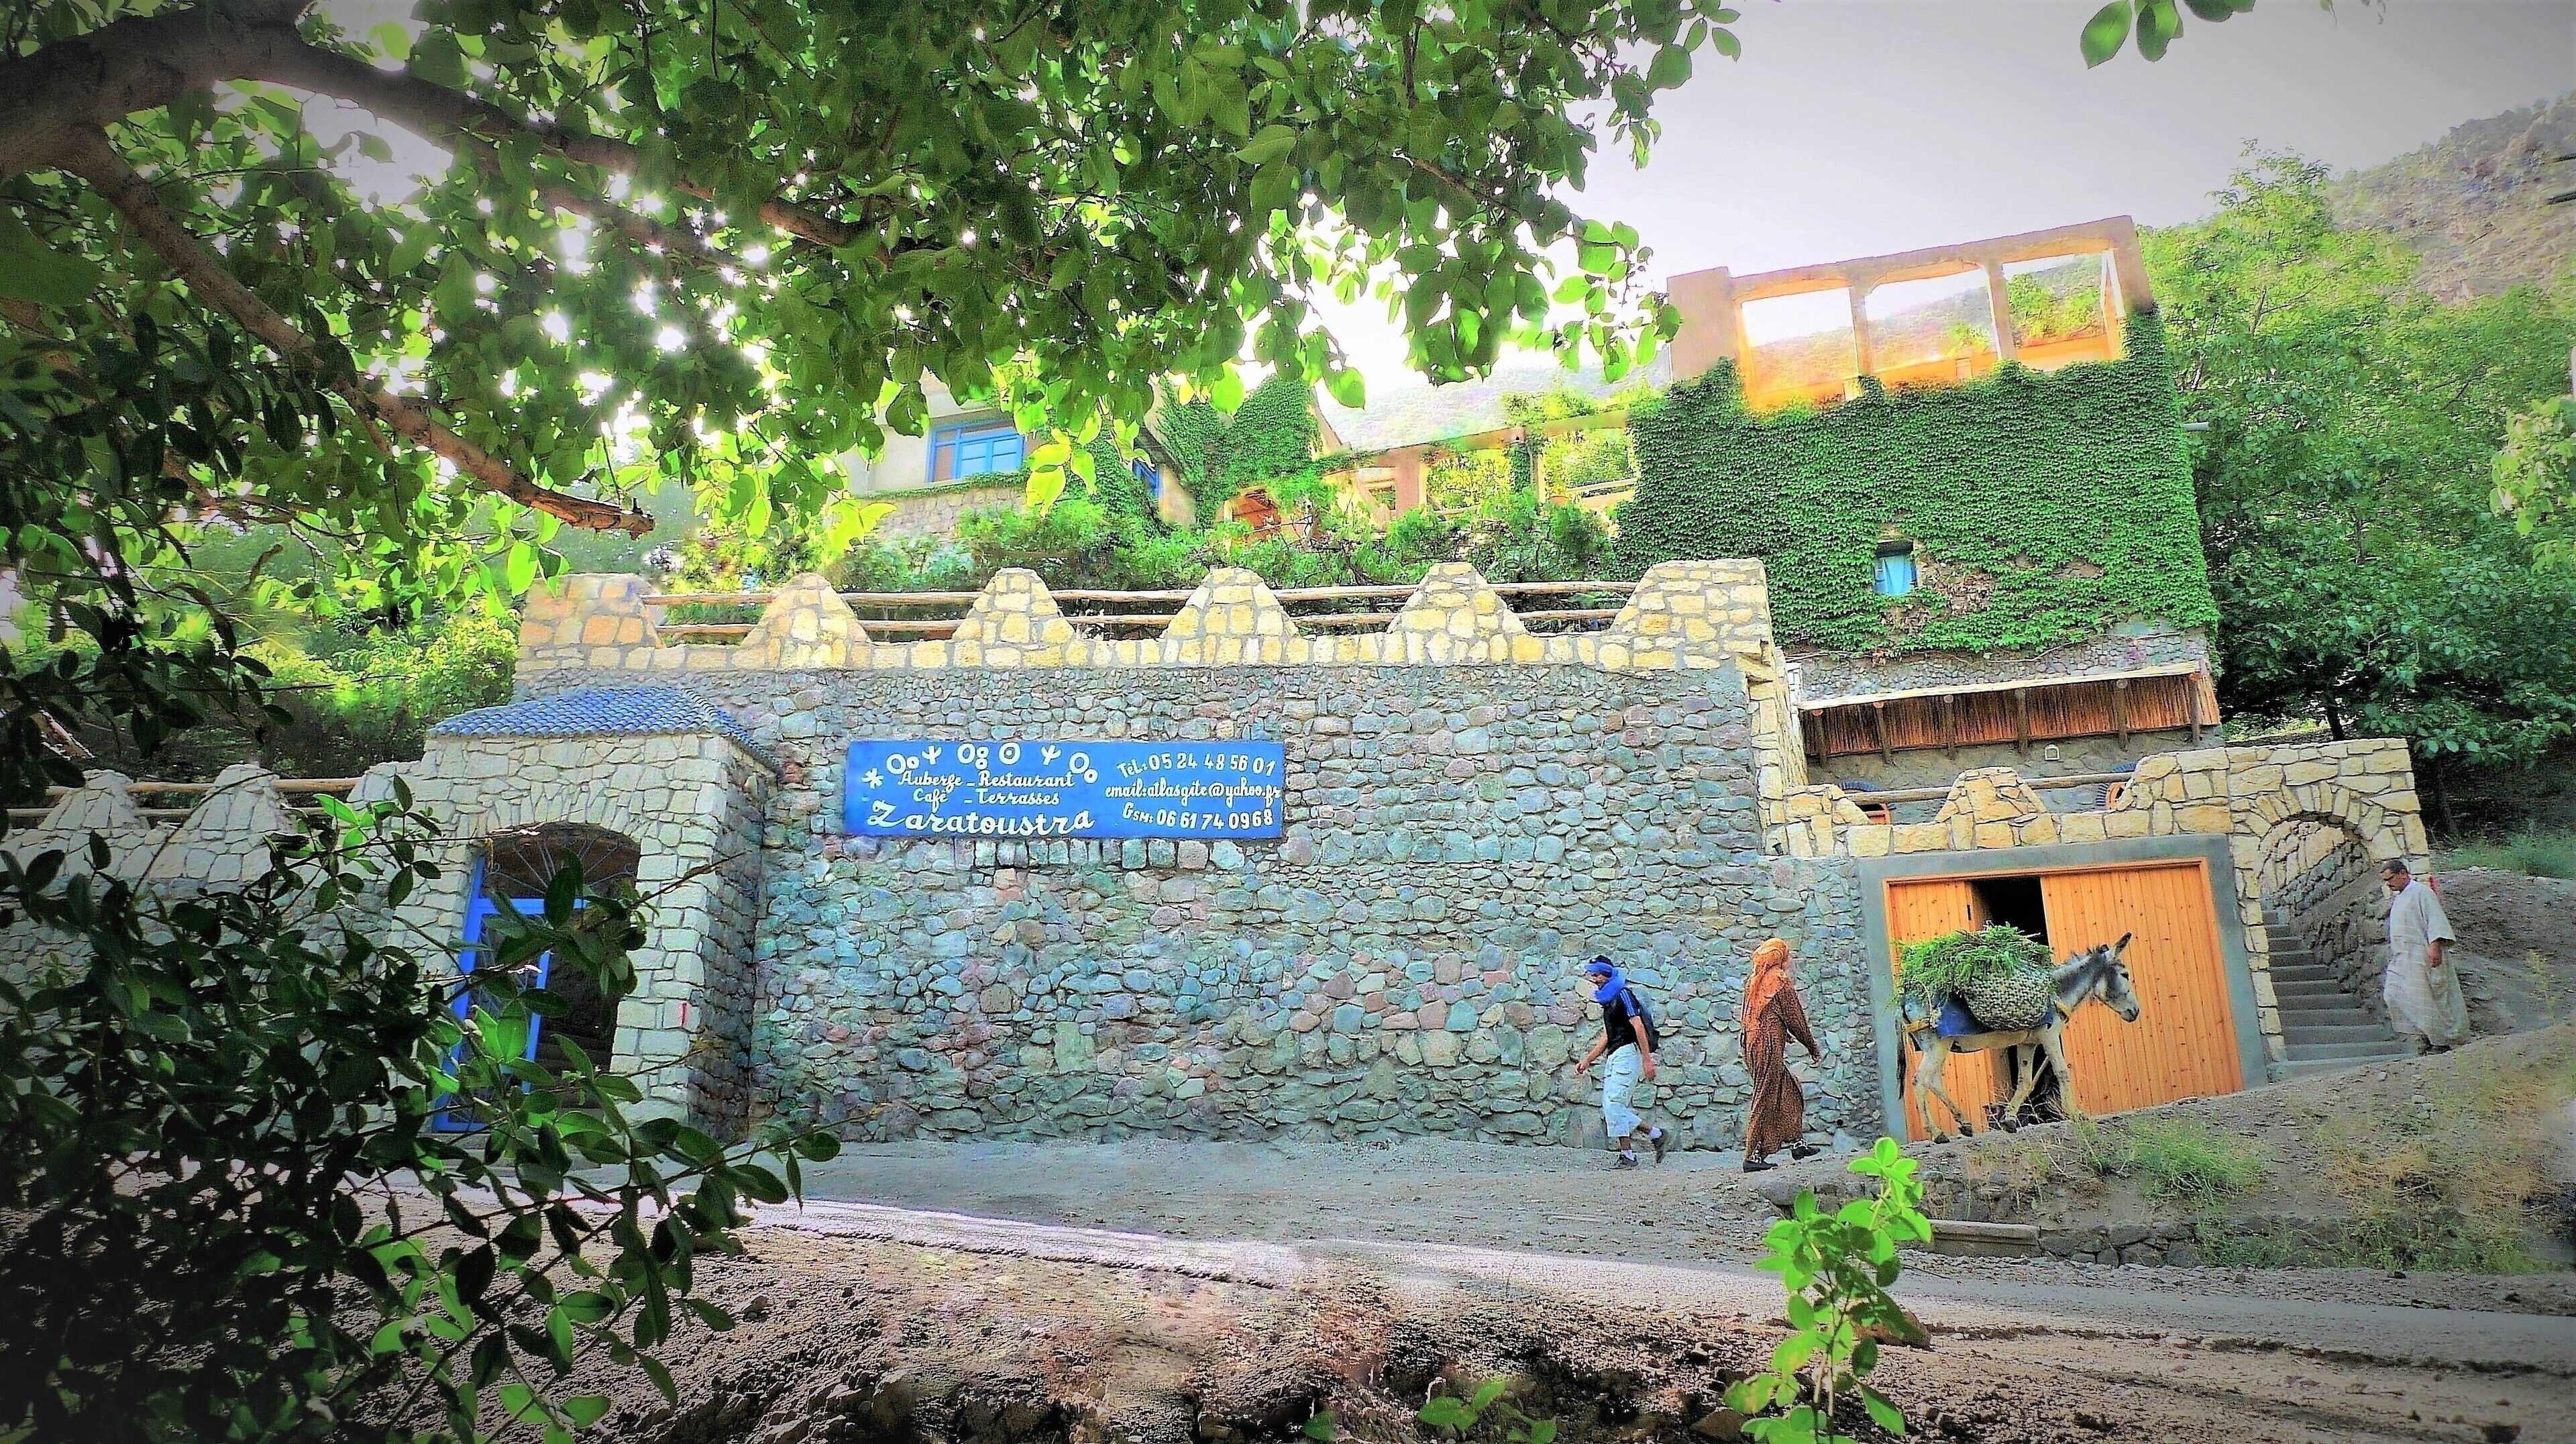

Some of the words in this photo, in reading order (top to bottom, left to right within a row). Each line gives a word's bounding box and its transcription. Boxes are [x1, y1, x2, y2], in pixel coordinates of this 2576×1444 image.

[1177, 752, 1198, 769] 24
[1203, 753, 1226, 771] 48
[1230, 754, 1248, 772] 56
[1252, 756, 1277, 777] 01
[898, 770, 963, 794] Auberge
[979, 770, 1075, 787] Restaurant
[913, 787, 949, 813] Café
[975, 788, 1060, 805] Terrasses
[867, 800, 1095, 835] Zaratoustra
[1157, 809, 1177, 827] 06
[1180, 812, 1197, 829] 61
[1200, 813, 1225, 831] 74
